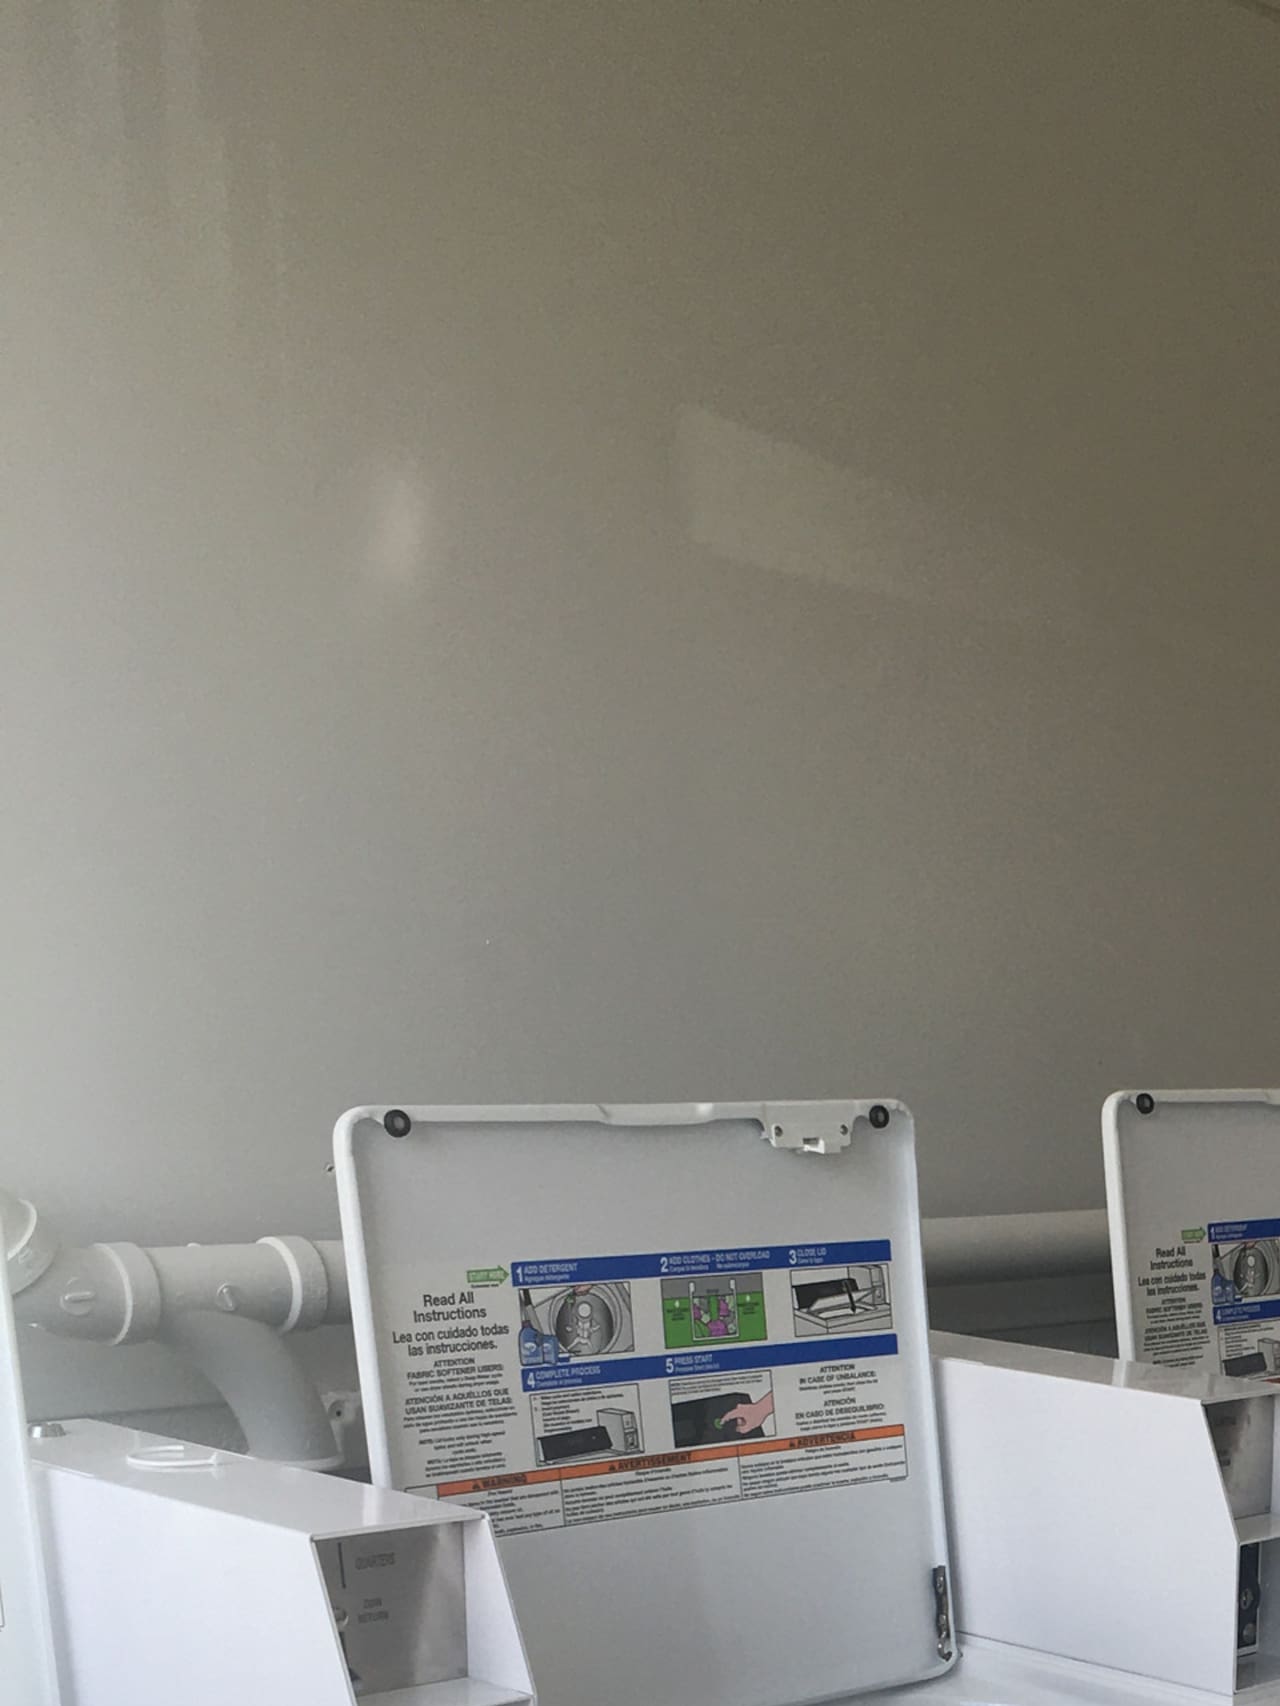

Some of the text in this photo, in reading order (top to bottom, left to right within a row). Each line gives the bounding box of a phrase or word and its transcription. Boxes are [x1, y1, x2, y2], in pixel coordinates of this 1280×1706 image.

[789, 1249, 797, 1265] 3
[1156, 1247, 1175, 1258] Read
[660, 1256, 668, 1272] 2
[1150, 1259, 1193, 1270] Instructions
[516, 1266, 523, 1282] 1
[423, 1291, 474, 1307] Read All
[413, 1307, 487, 1323] Instructions
[392, 1323, 510, 1344] Lea con cuidado todas
[408, 1340, 498, 1356] las instrucciones.
[433, 1358, 476, 1368] ATTENTION
[666, 1358, 674, 1373] 5
[436, 1366, 476, 1377] SOFTENER
[527, 1372, 535, 1388] 4
[494, 1388, 509, 1396] QUE
[405, 1405, 427, 1415] USAN
